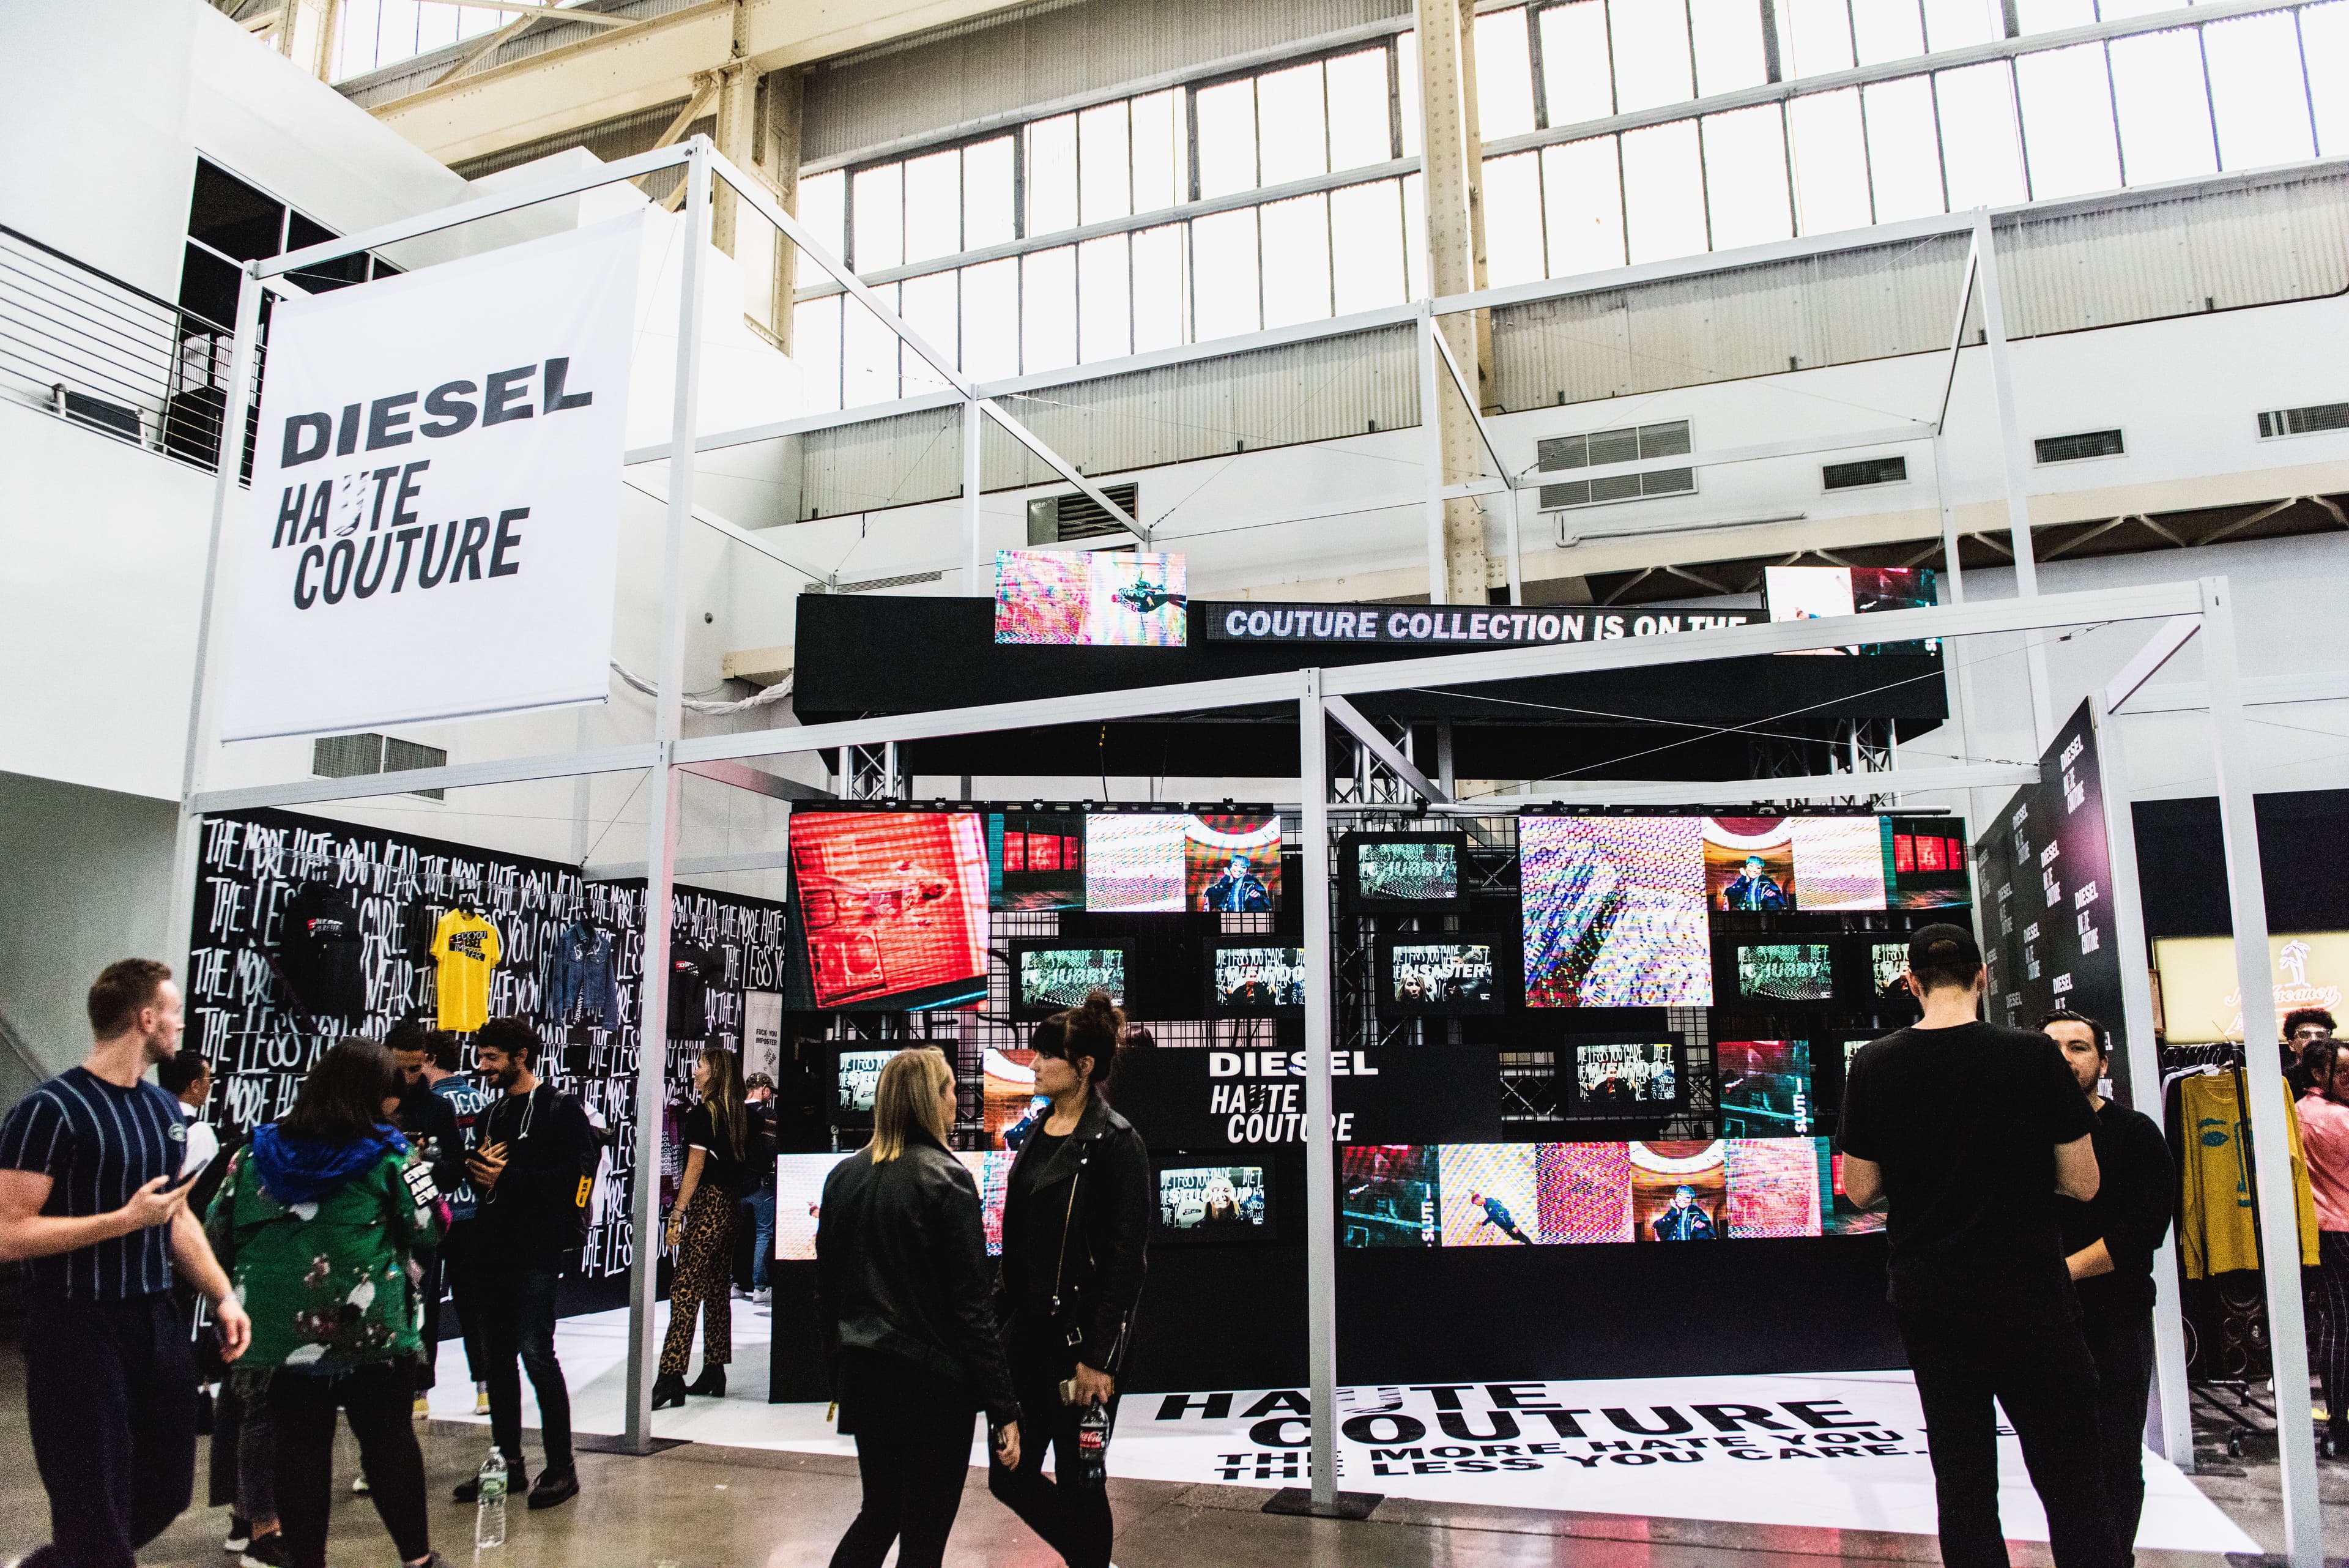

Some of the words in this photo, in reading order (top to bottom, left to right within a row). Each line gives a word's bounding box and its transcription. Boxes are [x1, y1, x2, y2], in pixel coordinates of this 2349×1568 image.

[280, 357, 593, 469] DIESEL
[271, 459, 431, 549] HAUTE
[294, 507, 530, 610] COUTURE
[1225, 611, 1379, 637] COUTURE
[1387, 612, 1584, 641] COLLECTION
[1594, 615, 1625, 641] IS
[1633, 616, 1680, 636] ON
[203, 819, 243, 874] THE
[238, 822, 290, 881] MORE
[420, 855, 450, 902] THE
[206, 876, 250, 943] THE
[2075, 880, 2098, 910] DIESEL
[737, 905, 761, 945] MORE
[760, 907, 784, 951] HATE
[191, 947, 232, 1003] THE
[721, 943, 742, 989] THE
[742, 943, 773, 990] LESS
[1264, 948, 1286, 966] CARE
[1400, 964, 1485, 979] DISASTER
[365, 958, 416, 1018] WEAR
[2053, 972, 2073, 995] DIESEL
[195, 1007, 240, 1074] THE
[755, 1038, 777, 1046] IMPOSTER
[1624, 1044, 1645, 1063] CARE
[1209, 1051, 1378, 1077] DIESEL
[217, 1075, 273, 1135] MORE
[603, 1077, 631, 1123] MORE
[1211, 1085, 1300, 1114] HAUTE
[1155, 1384, 1563, 1421] HAUTE
[1249, 1399, 1881, 1448] COUTURE
[1370, 1443, 1567, 1462] MORE
[1588, 1435, 1757, 1452] HATE
[1770, 1429, 1906, 1445] YOU
[1373, 1458, 1545, 1476] LESS
[1562, 1450, 1704, 1468] YOU
[1727, 1444, 1929, 1461] CARE.
